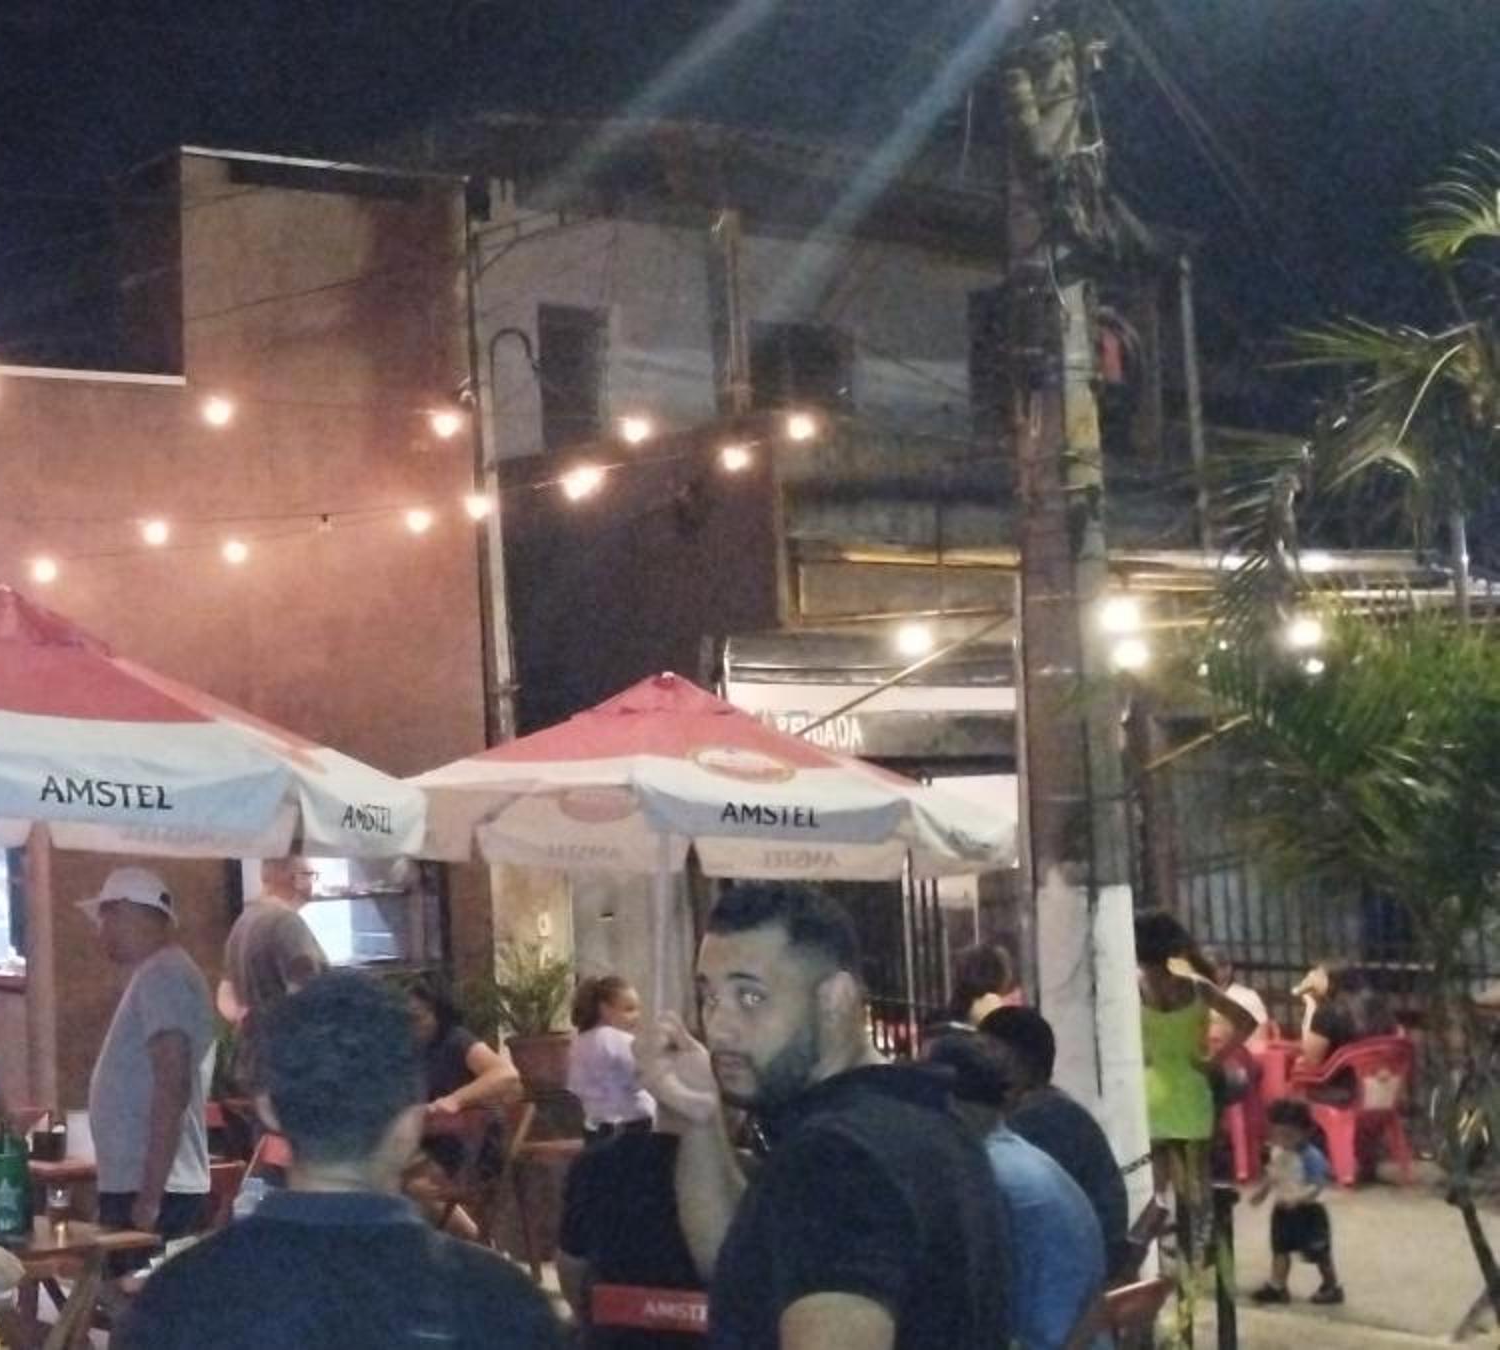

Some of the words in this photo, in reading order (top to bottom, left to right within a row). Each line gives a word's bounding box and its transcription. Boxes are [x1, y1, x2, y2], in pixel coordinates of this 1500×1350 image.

[40, 774, 174, 811] AMSTEL
[340, 803, 393, 835] AMSTEL
[721, 801, 821, 829] AMSTEL
